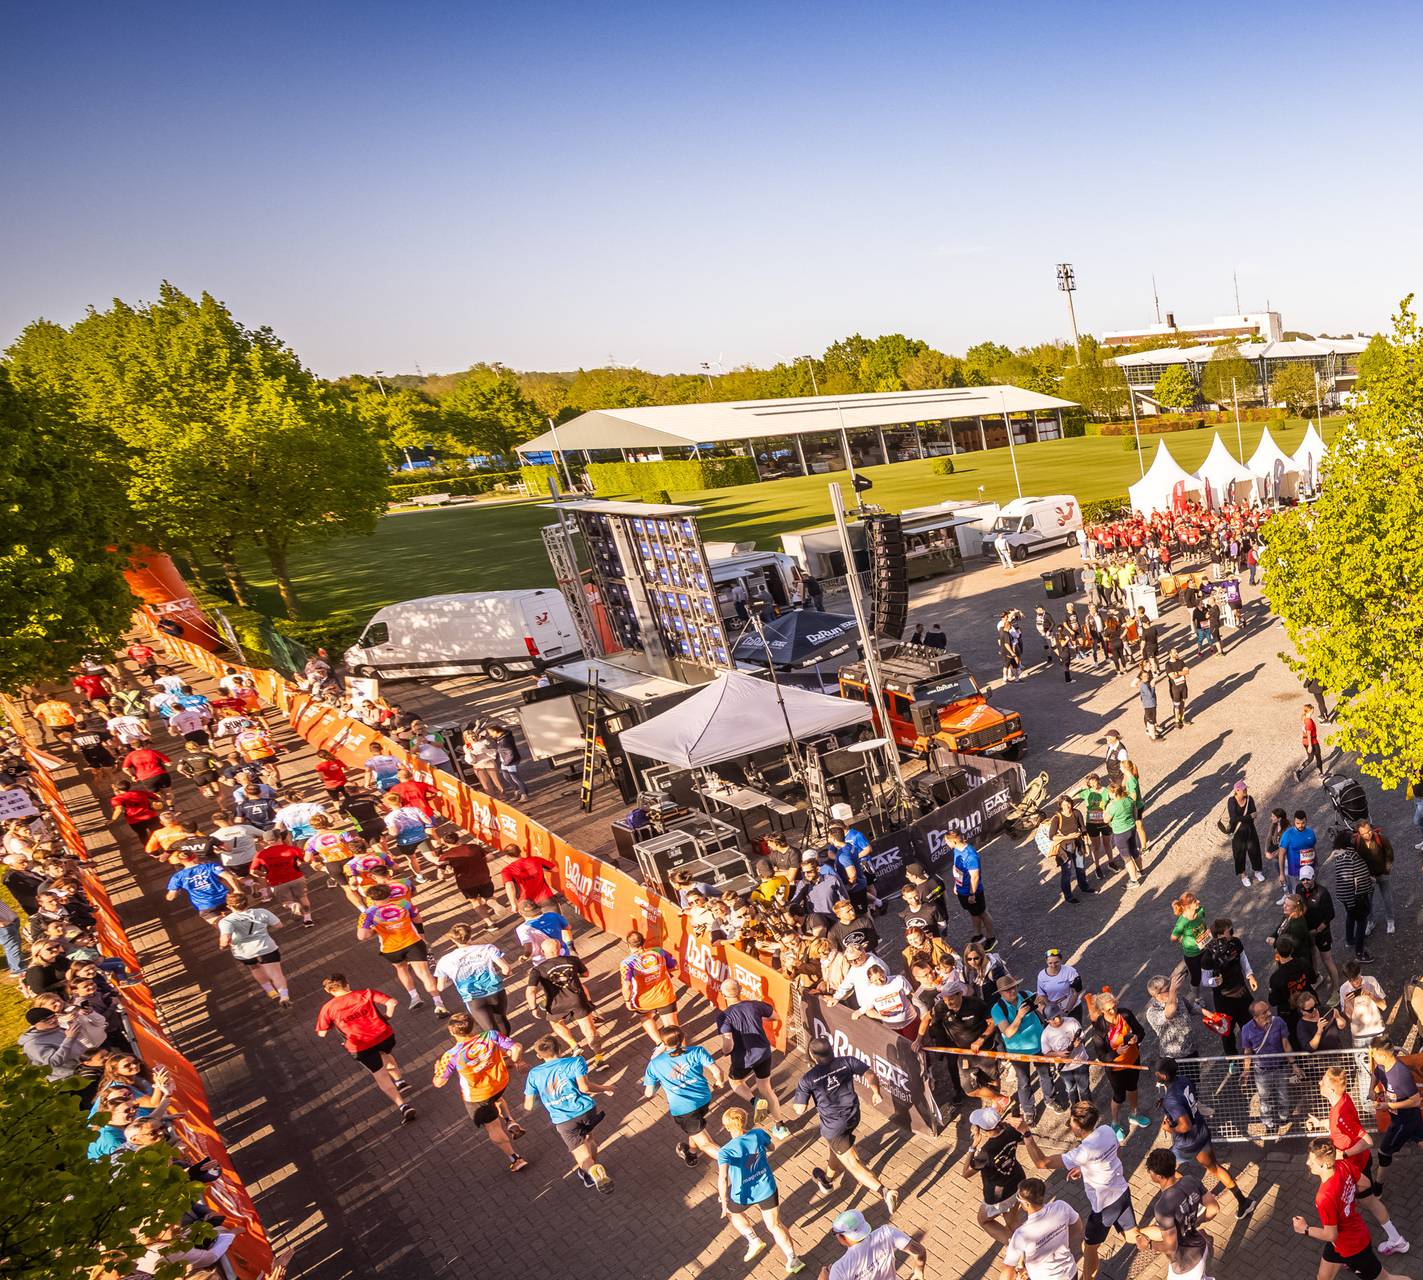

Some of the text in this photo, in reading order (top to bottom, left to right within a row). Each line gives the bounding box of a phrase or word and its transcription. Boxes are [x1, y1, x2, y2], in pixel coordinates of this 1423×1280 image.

[805, 626, 843, 643] B2Run
[984, 787, 1011, 811] DAK
[686, 933, 731, 983] B2Run
[874, 1053, 911, 1092] DAK
